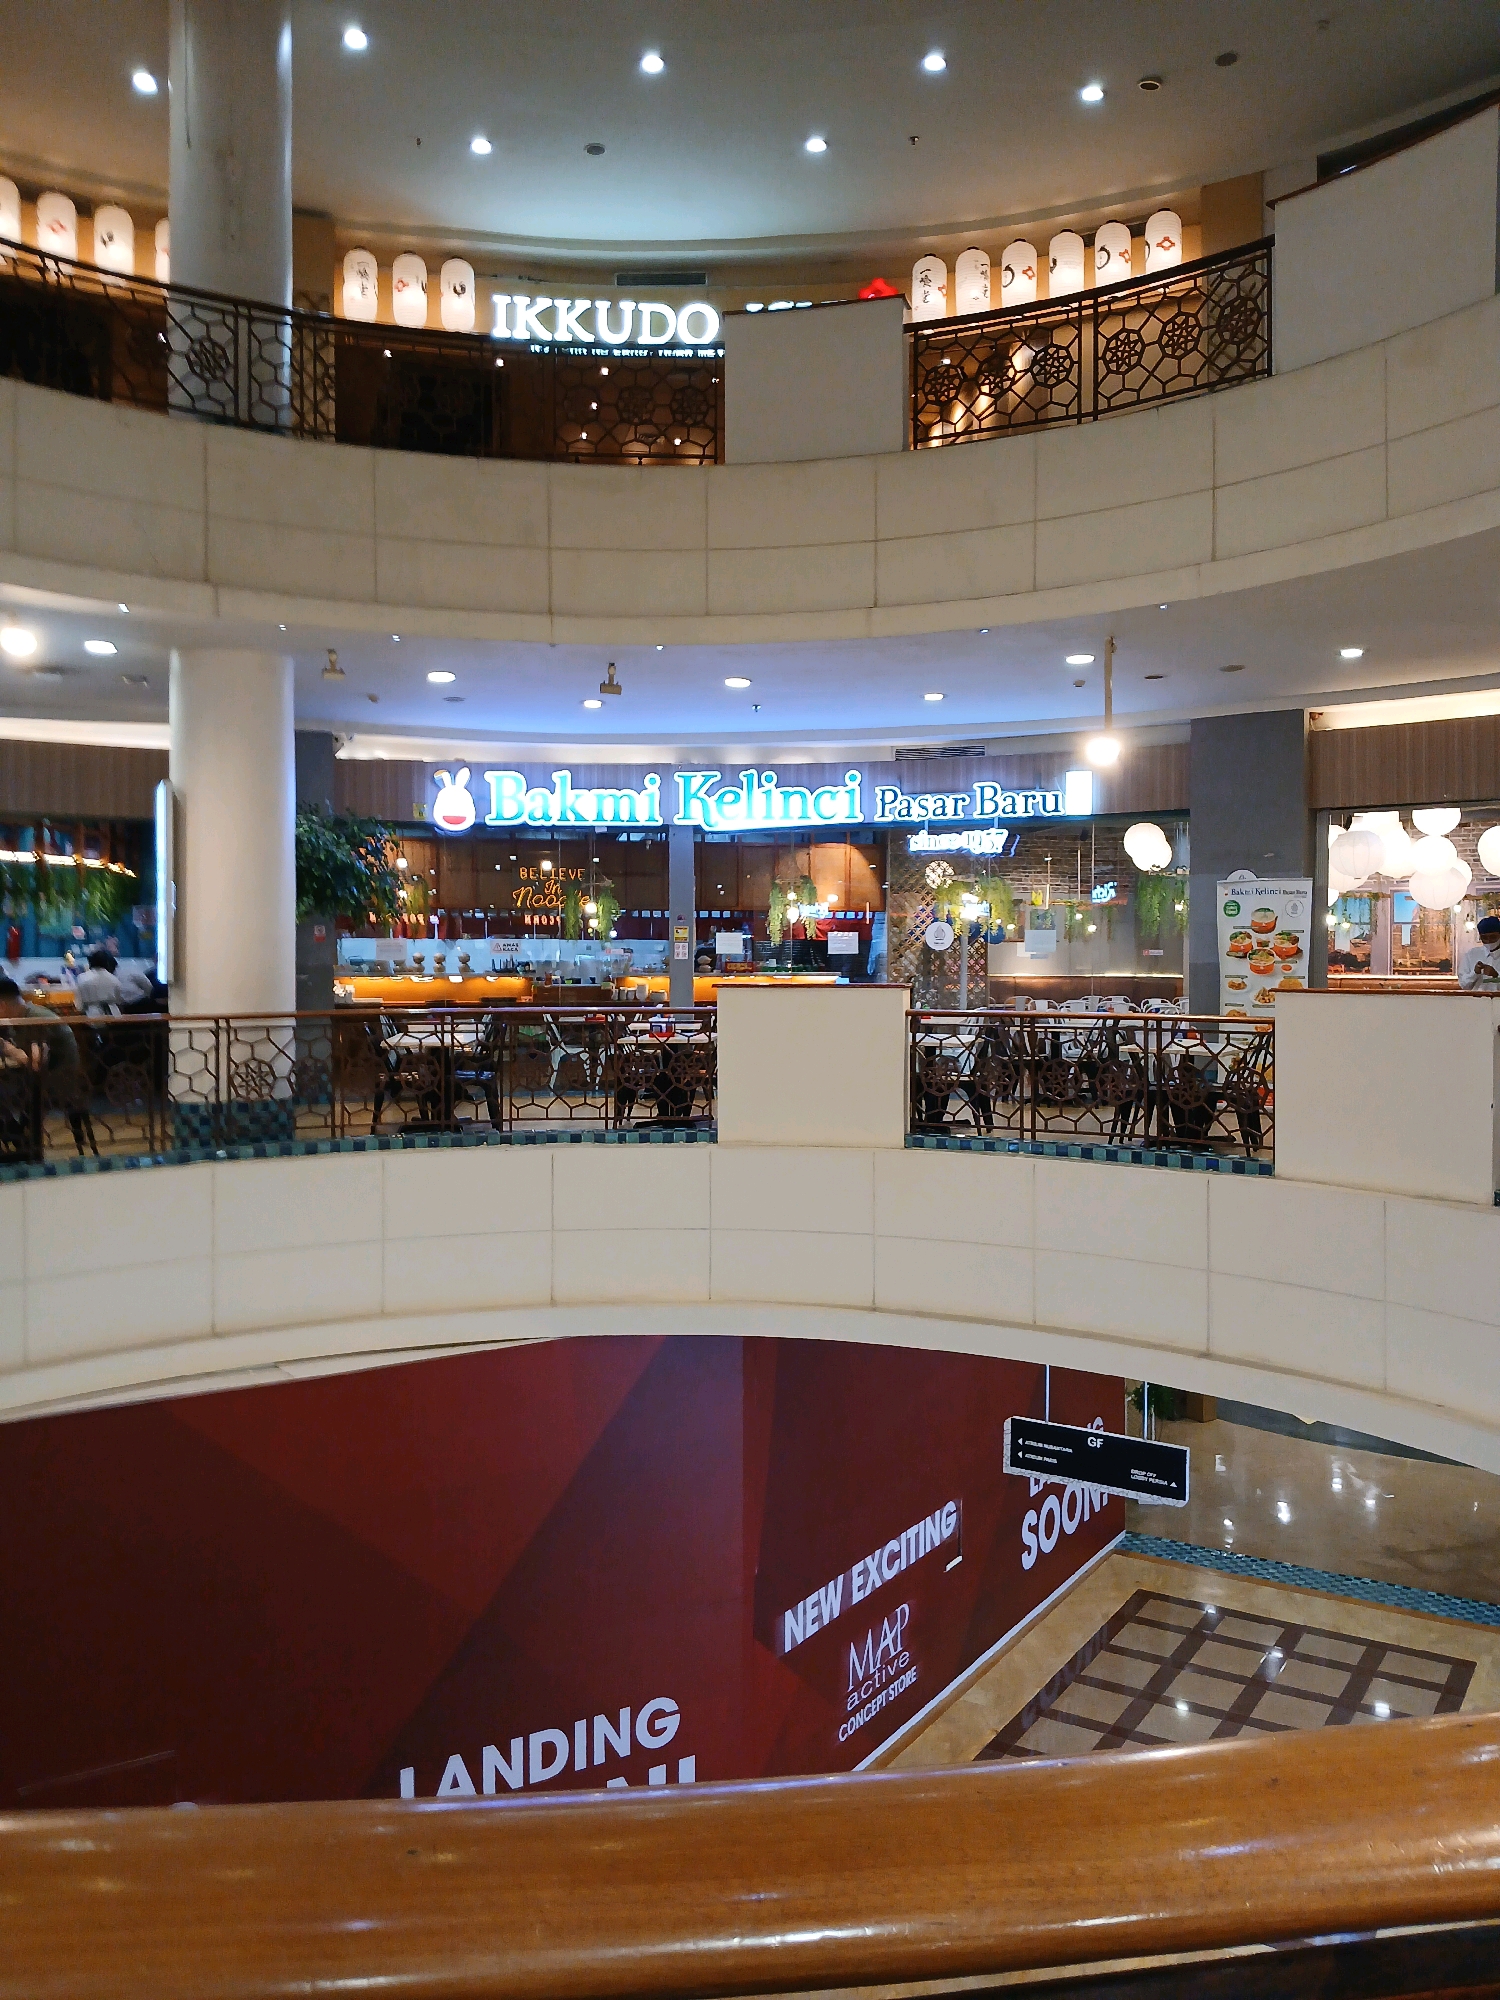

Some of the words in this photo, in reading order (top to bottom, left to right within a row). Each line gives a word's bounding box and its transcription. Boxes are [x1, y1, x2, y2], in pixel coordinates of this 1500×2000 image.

[492, 294, 720, 345] IKKUDO
[486, 769, 664, 828] Bakmi
[672, 768, 864, 832] Kelinci
[875, 785, 969, 821] Pasar
[972, 781, 1065, 818] Baru
[519, 866, 586, 880] BELIEVE
[1087, 1436, 1104, 1449] GF
[784, 1574, 844, 1653] NEW
[851, 1501, 957, 1606] EXCITING
[847, 1603, 910, 1693] MAP
[838, 1694, 887, 1742] CONCEPT
[888, 1665, 917, 1701] STORE
[847, 1651, 910, 1712] active
